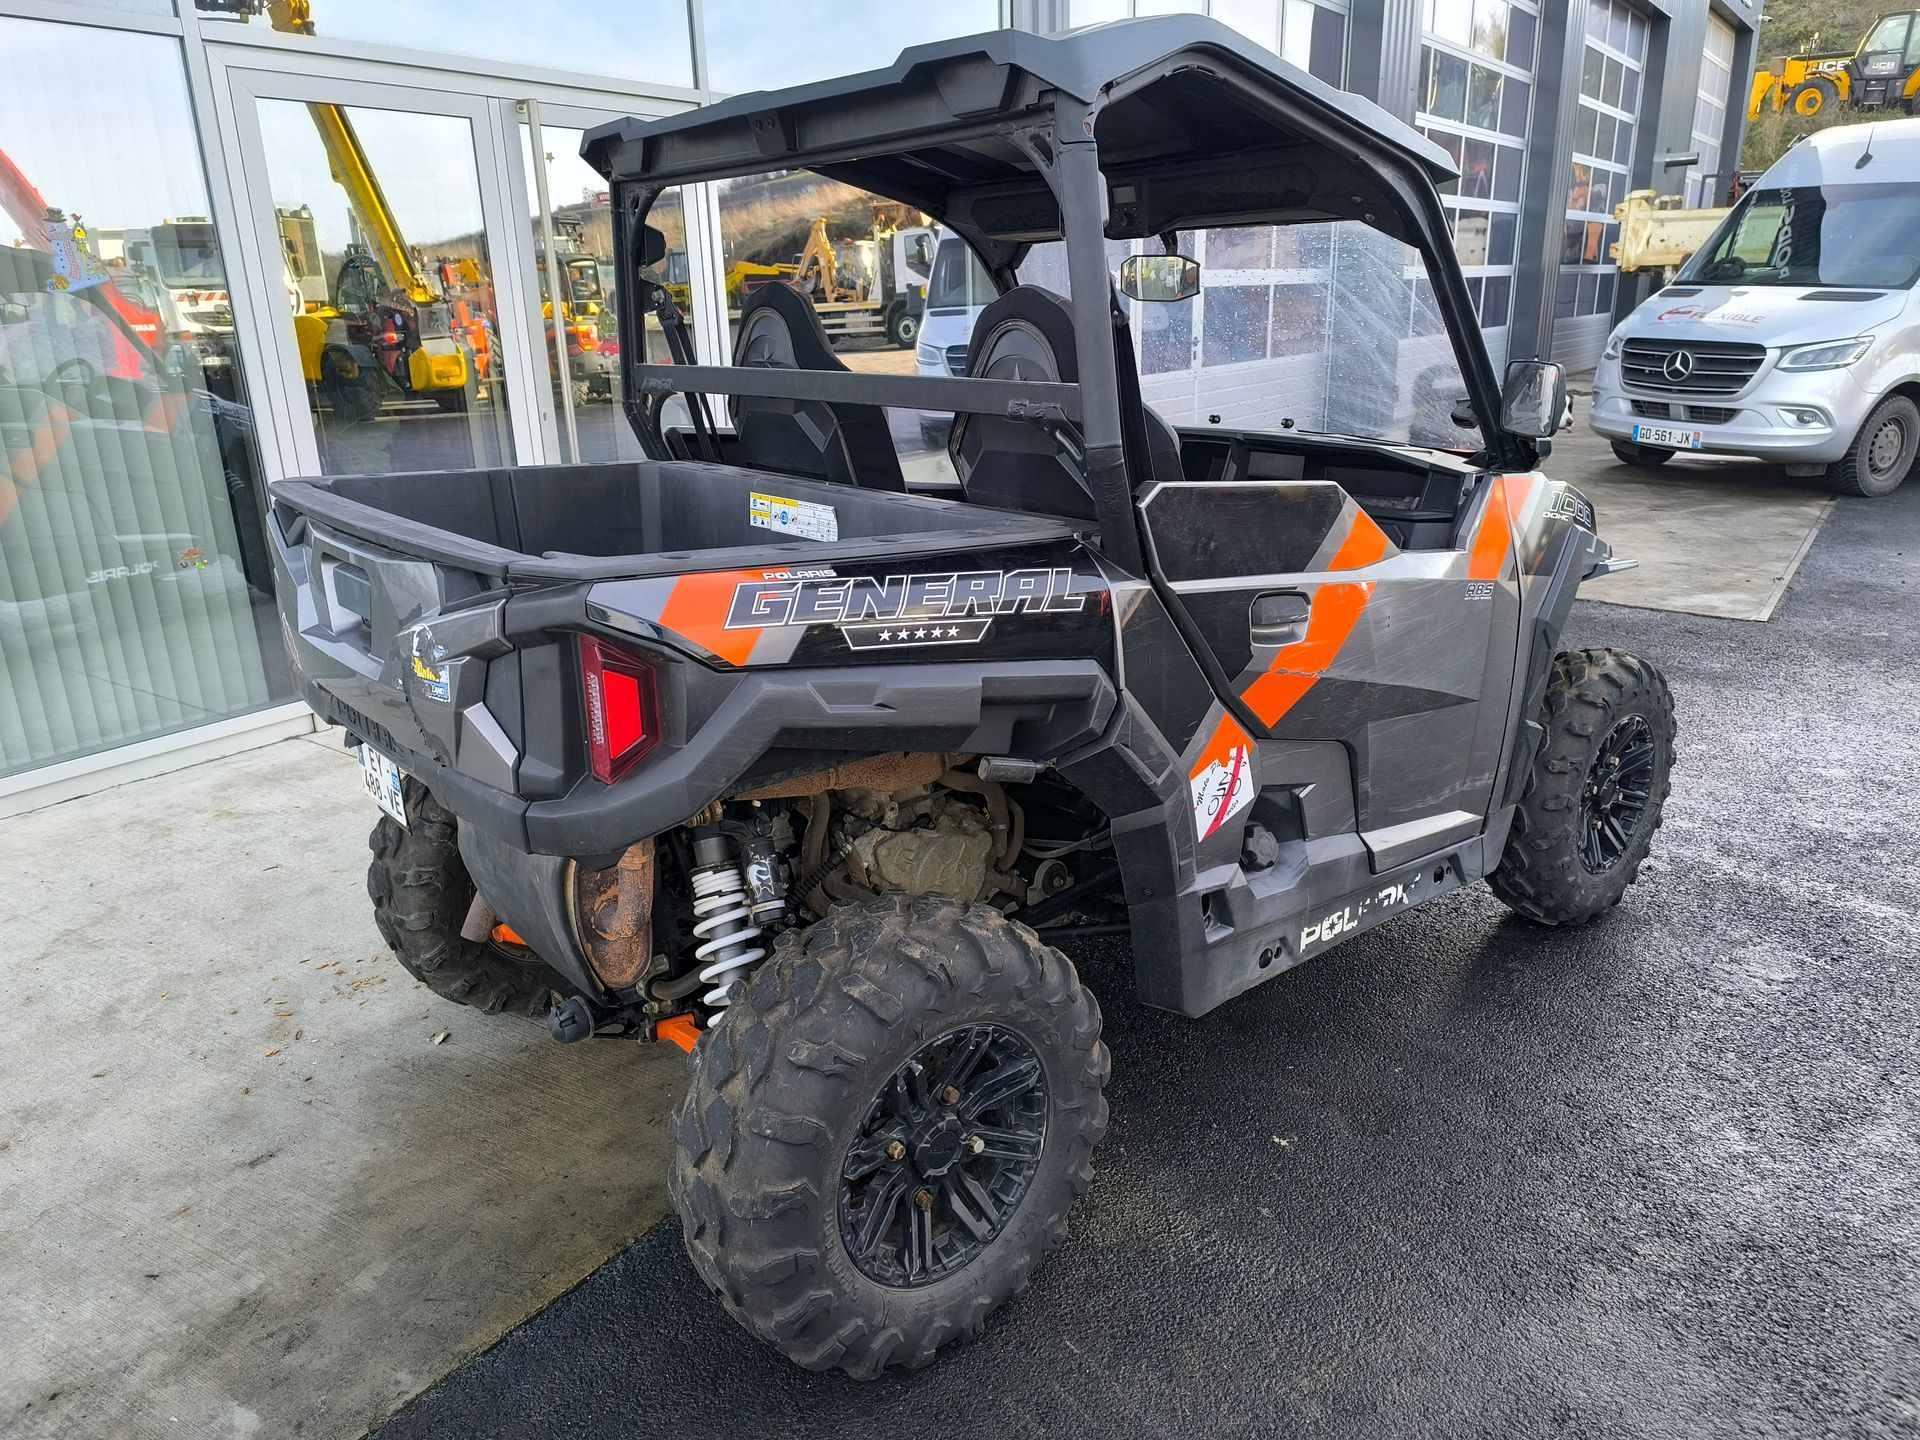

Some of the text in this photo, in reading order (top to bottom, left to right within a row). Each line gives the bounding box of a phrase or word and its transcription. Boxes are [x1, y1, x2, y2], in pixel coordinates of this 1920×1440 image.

[1872, 61, 1896, 70] JCB
[1550, 490, 1592, 528] 1000
[1542, 511, 1570, 521] DOHC
[761, 569, 838, 580] POLARIS
[1465, 582, 1495, 597] ABS
[723, 567, 1086, 631] GENERAL
